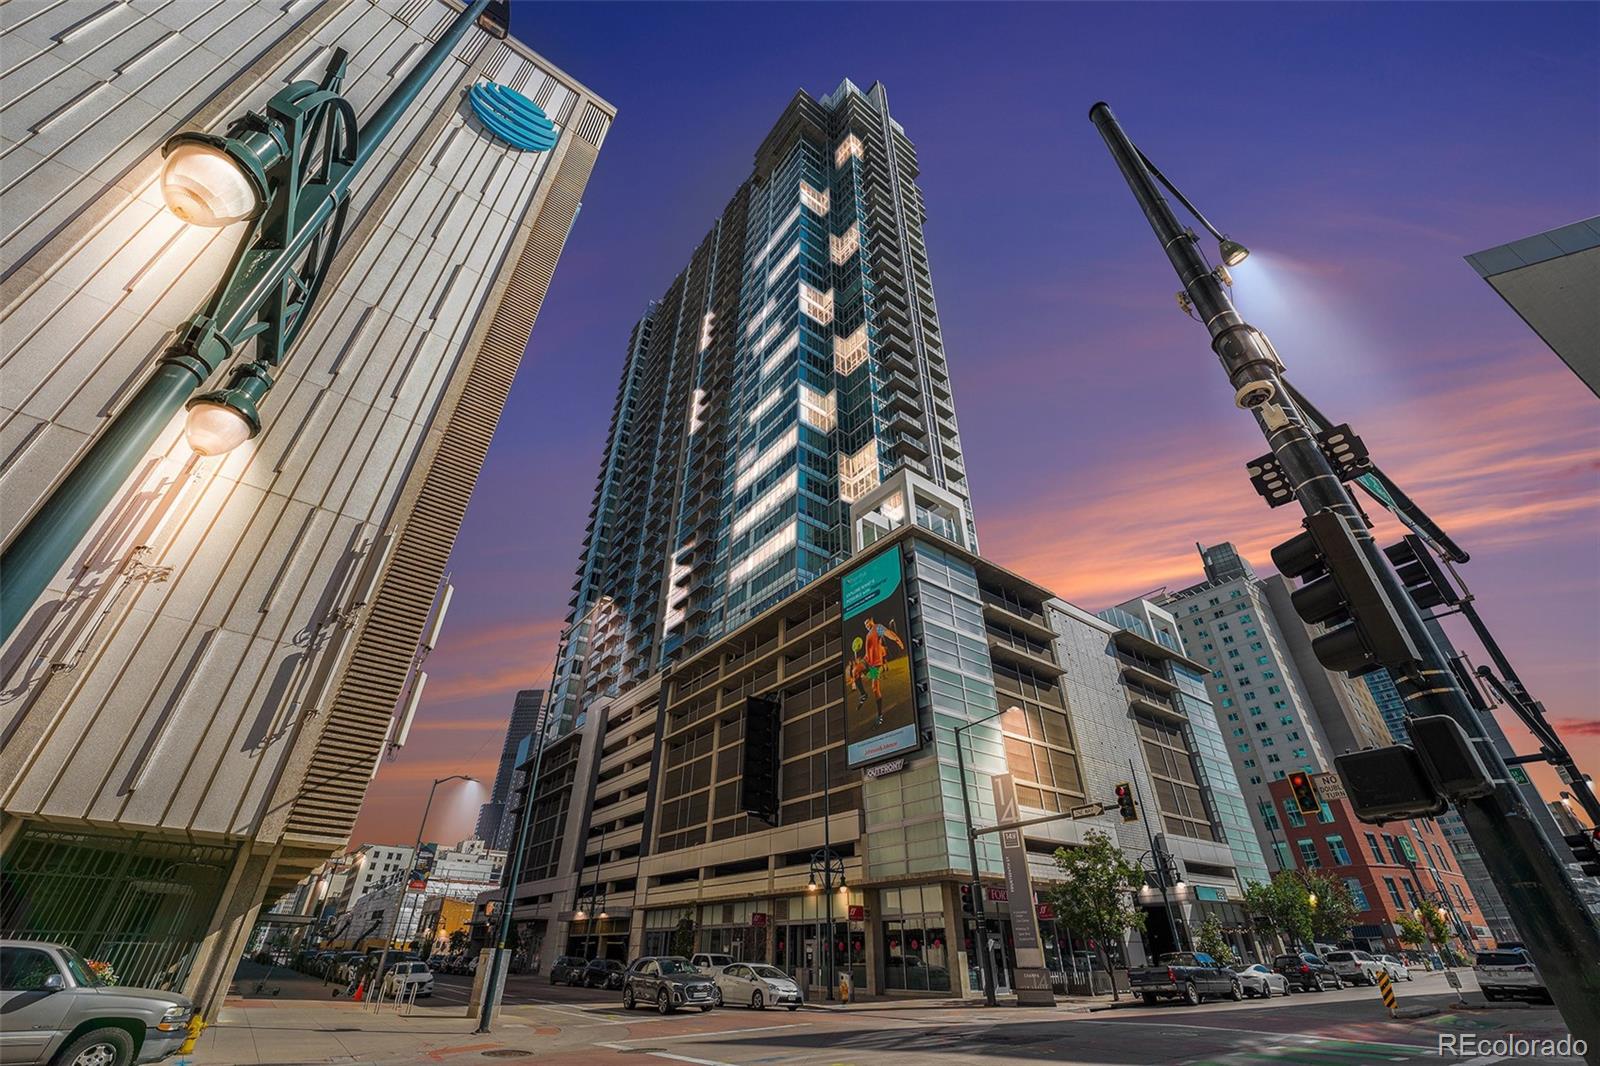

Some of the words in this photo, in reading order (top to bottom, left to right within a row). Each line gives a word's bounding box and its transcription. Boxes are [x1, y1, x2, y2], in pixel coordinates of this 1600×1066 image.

[1322, 775, 1337, 784] NO
[1320, 784, 1343, 793] DOUBL
[1326, 790, 1346, 798] TURN
